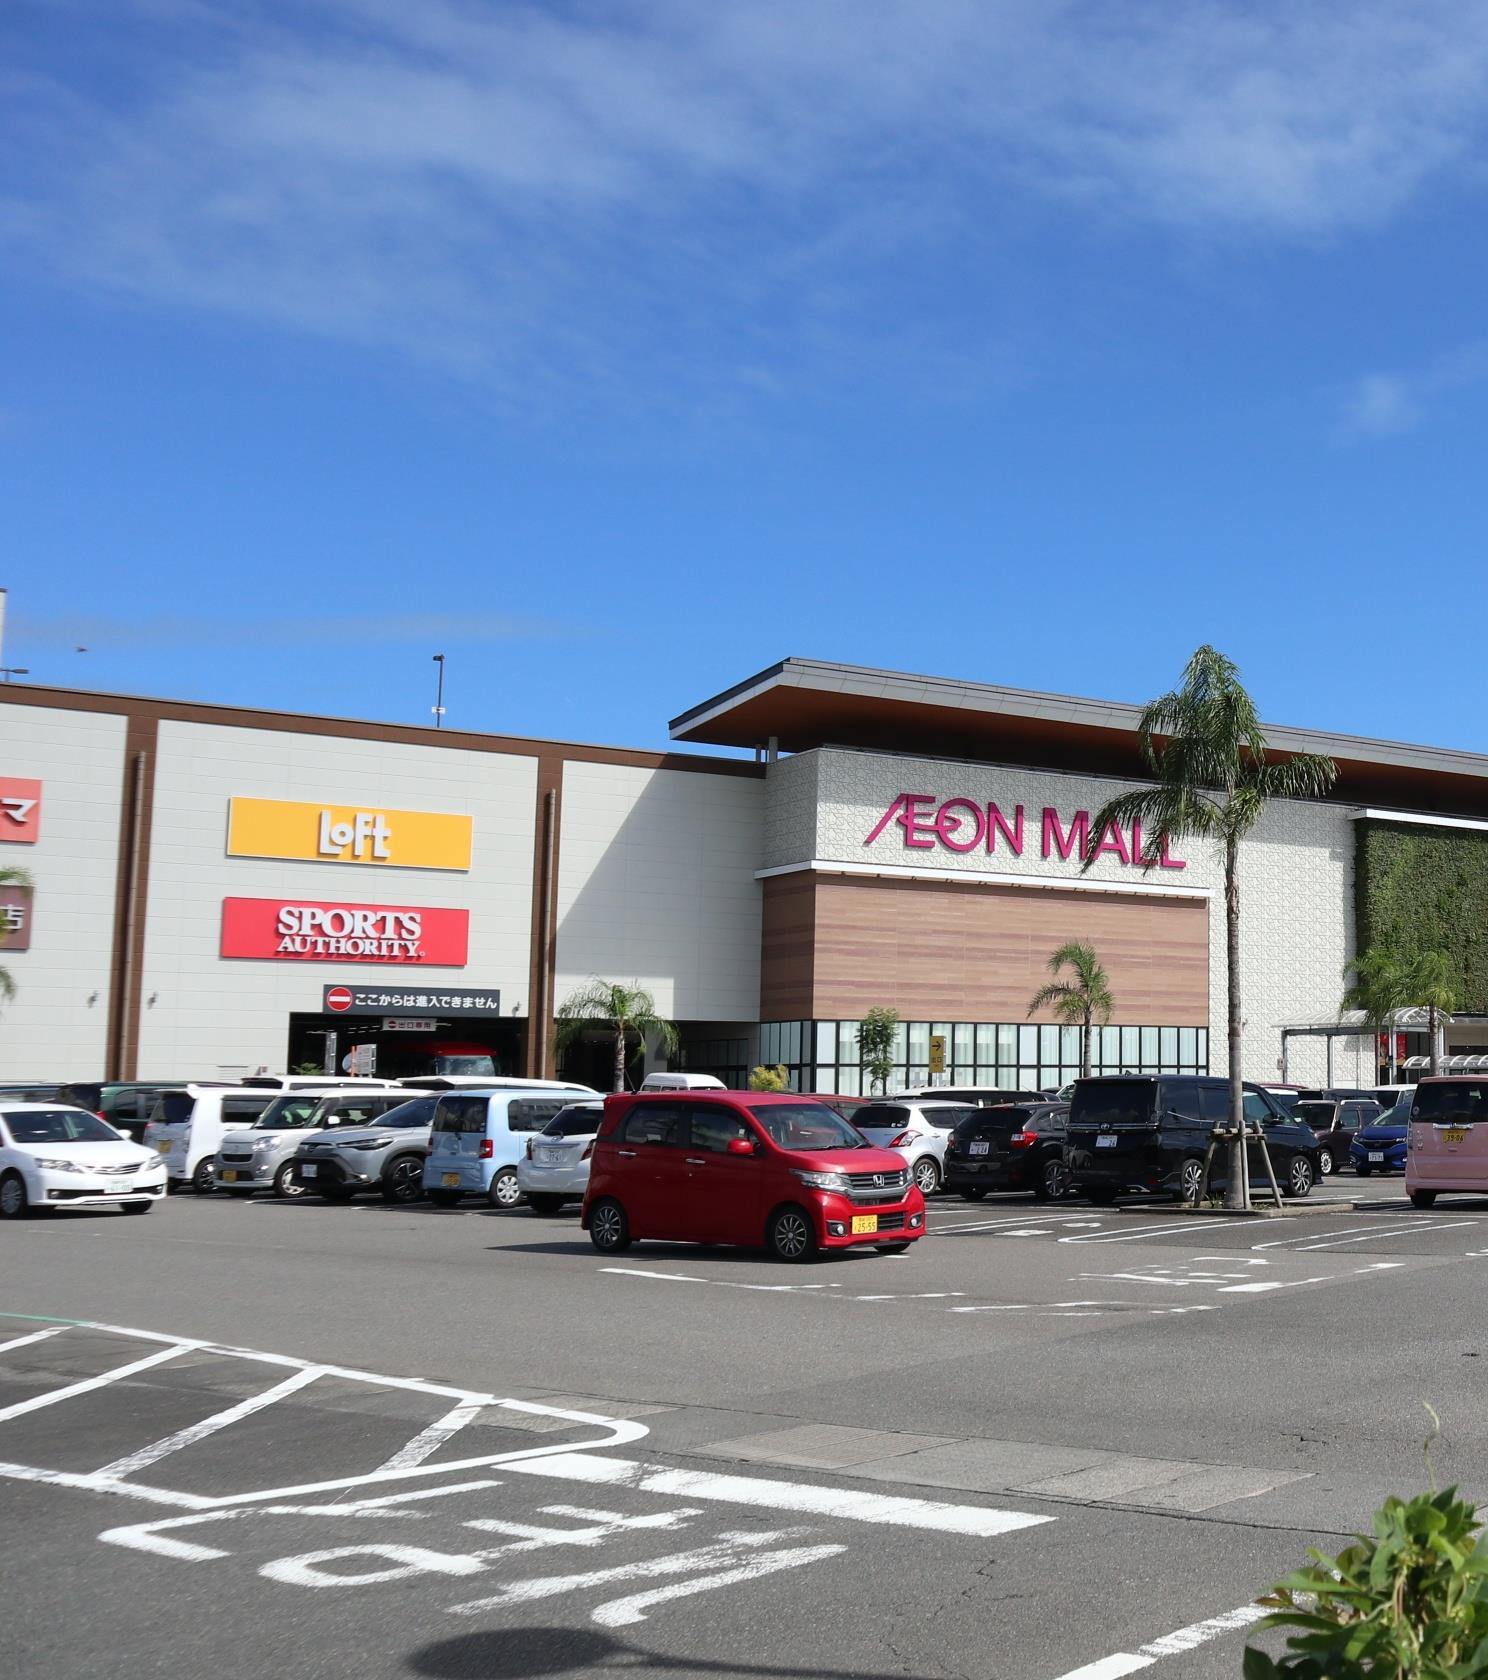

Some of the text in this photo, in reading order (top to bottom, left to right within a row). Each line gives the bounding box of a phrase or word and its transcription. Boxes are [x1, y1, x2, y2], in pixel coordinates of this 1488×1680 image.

[277, 906, 422, 940] SPORTS
[355, 993, 498, 1010] ここからは進入できません
